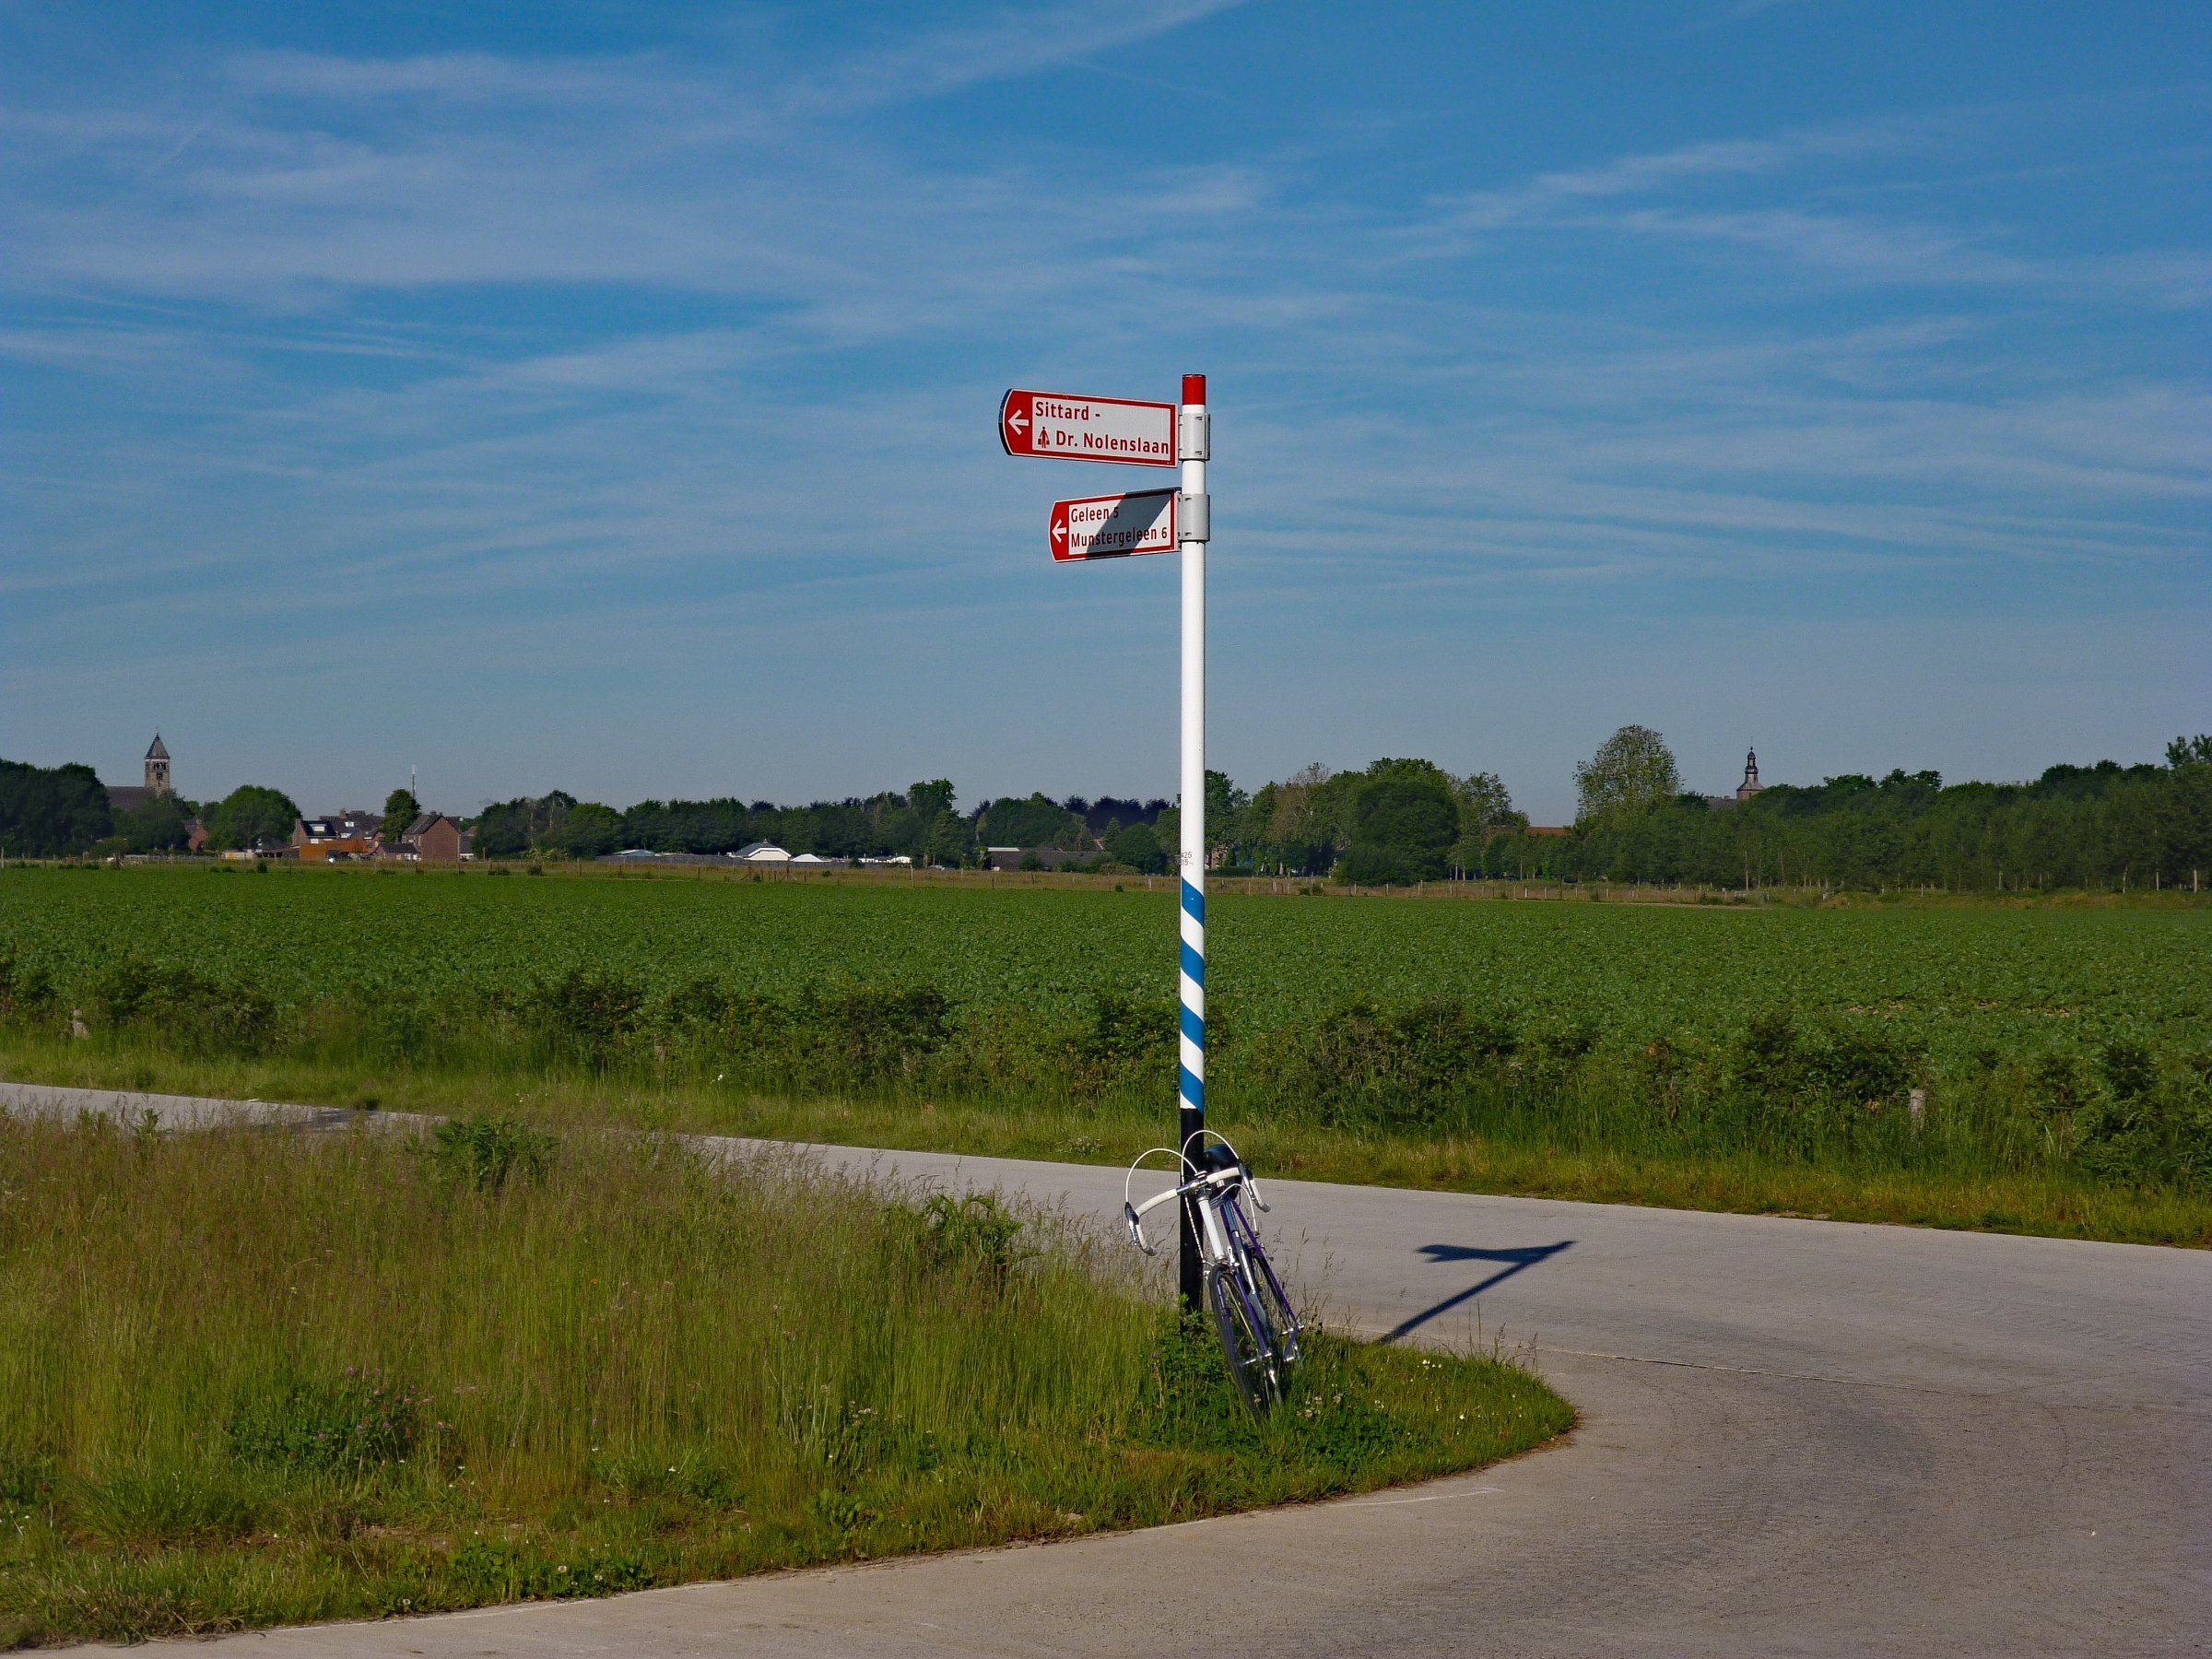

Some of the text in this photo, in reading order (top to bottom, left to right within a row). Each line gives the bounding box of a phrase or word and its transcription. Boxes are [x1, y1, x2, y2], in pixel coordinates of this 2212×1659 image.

[1035, 401, 1089, 420] Sittard
[1055, 430, 1169, 454] Dr. Nolenslaan
[1071, 506, 1119, 523] Geleen 5
[1071, 526, 1168, 547] Munstergeleen 6
